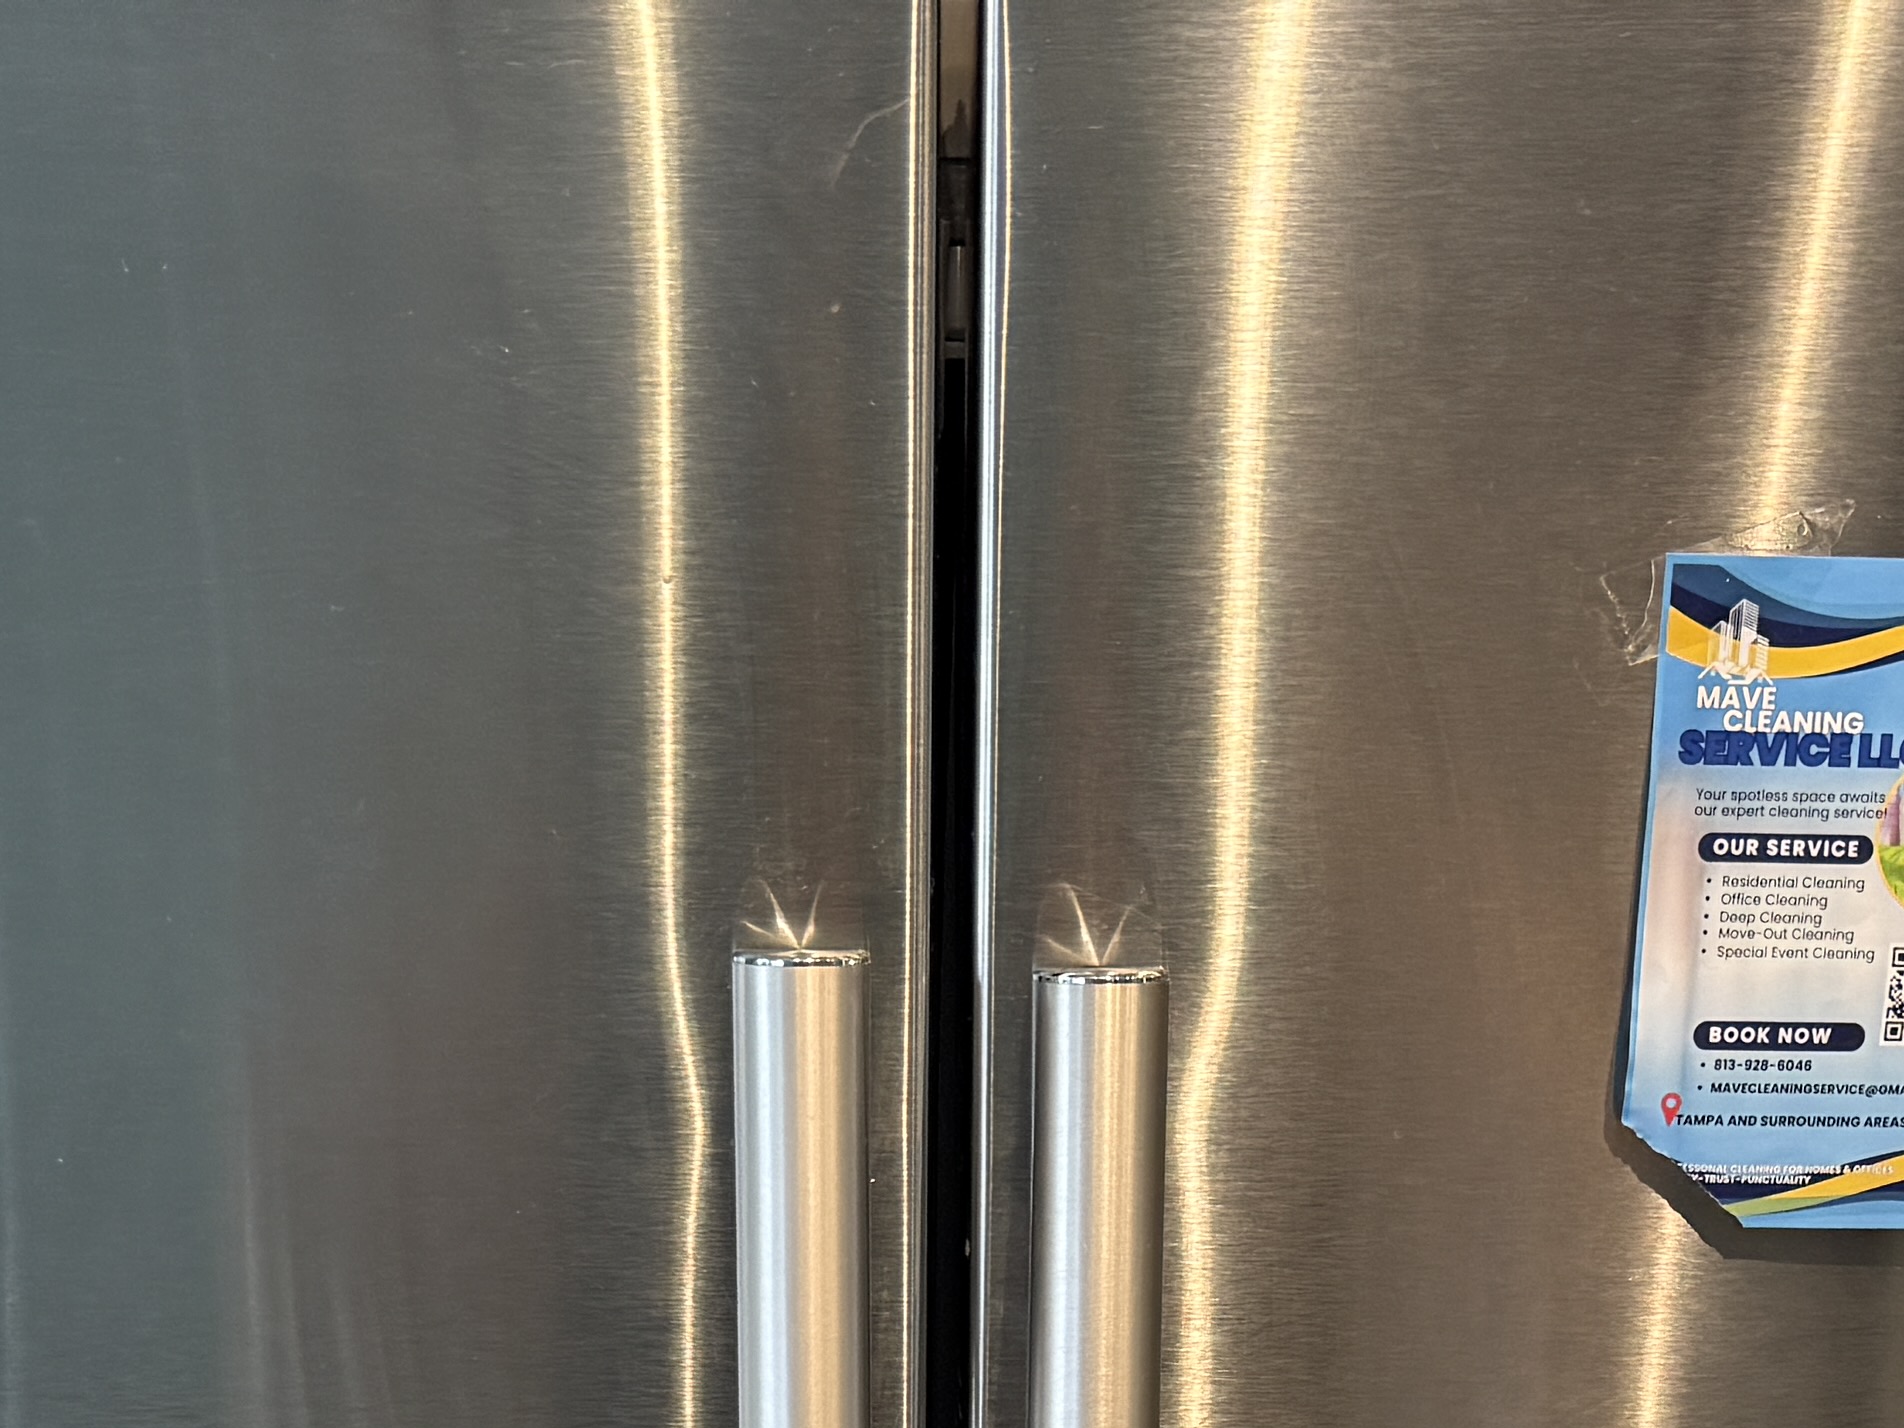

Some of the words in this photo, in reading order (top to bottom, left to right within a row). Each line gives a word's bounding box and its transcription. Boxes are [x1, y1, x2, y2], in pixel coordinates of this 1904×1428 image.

[1696, 686, 1777, 710] MAVE
[1723, 709, 1864, 735] CLEANING
[1678, 729, 1853, 768] SERVICE
[1695, 788, 1727, 802] Your
[1731, 789, 1788, 806] spotless
[1792, 791, 1836, 807] space
[1839, 790, 1886, 804] awaits
[1694, 807, 1717, 817] our
[1721, 806, 1765, 820] expert
[1769, 806, 1830, 822] cleaning
[1834, 806, 1888, 820] service!
[1712, 837, 1760, 858] OUR
[1766, 838, 1859, 858] SERVICE
[1722, 875, 1798, 889] Residential
[1802, 876, 1865, 892] Cleaning
[1720, 893, 1761, 906] Office
[1765, 893, 1828, 910] Cleaning
[1719, 911, 1755, 925] Deep
[1760, 911, 1823, 928] Cleaning
[1718, 928, 1787, 941] Move-Out
[1792, 928, 1854, 945] Cleaning
[1717, 945, 1768, 960] Special
[1772, 946, 1809, 959] Event
[1812, 947, 1875, 963] Cleaning
[1708, 1026, 1770, 1044] BOOK
[1777, 1026, 1832, 1045] NOW
[1714, 1058, 1812, 1071] 813-928-6046
[1676, 1113, 1724, 1127] TAMPA
[1727, 1114, 1757, 1127] AND
[1760, 1114, 1861, 1128] SURROUNDING
